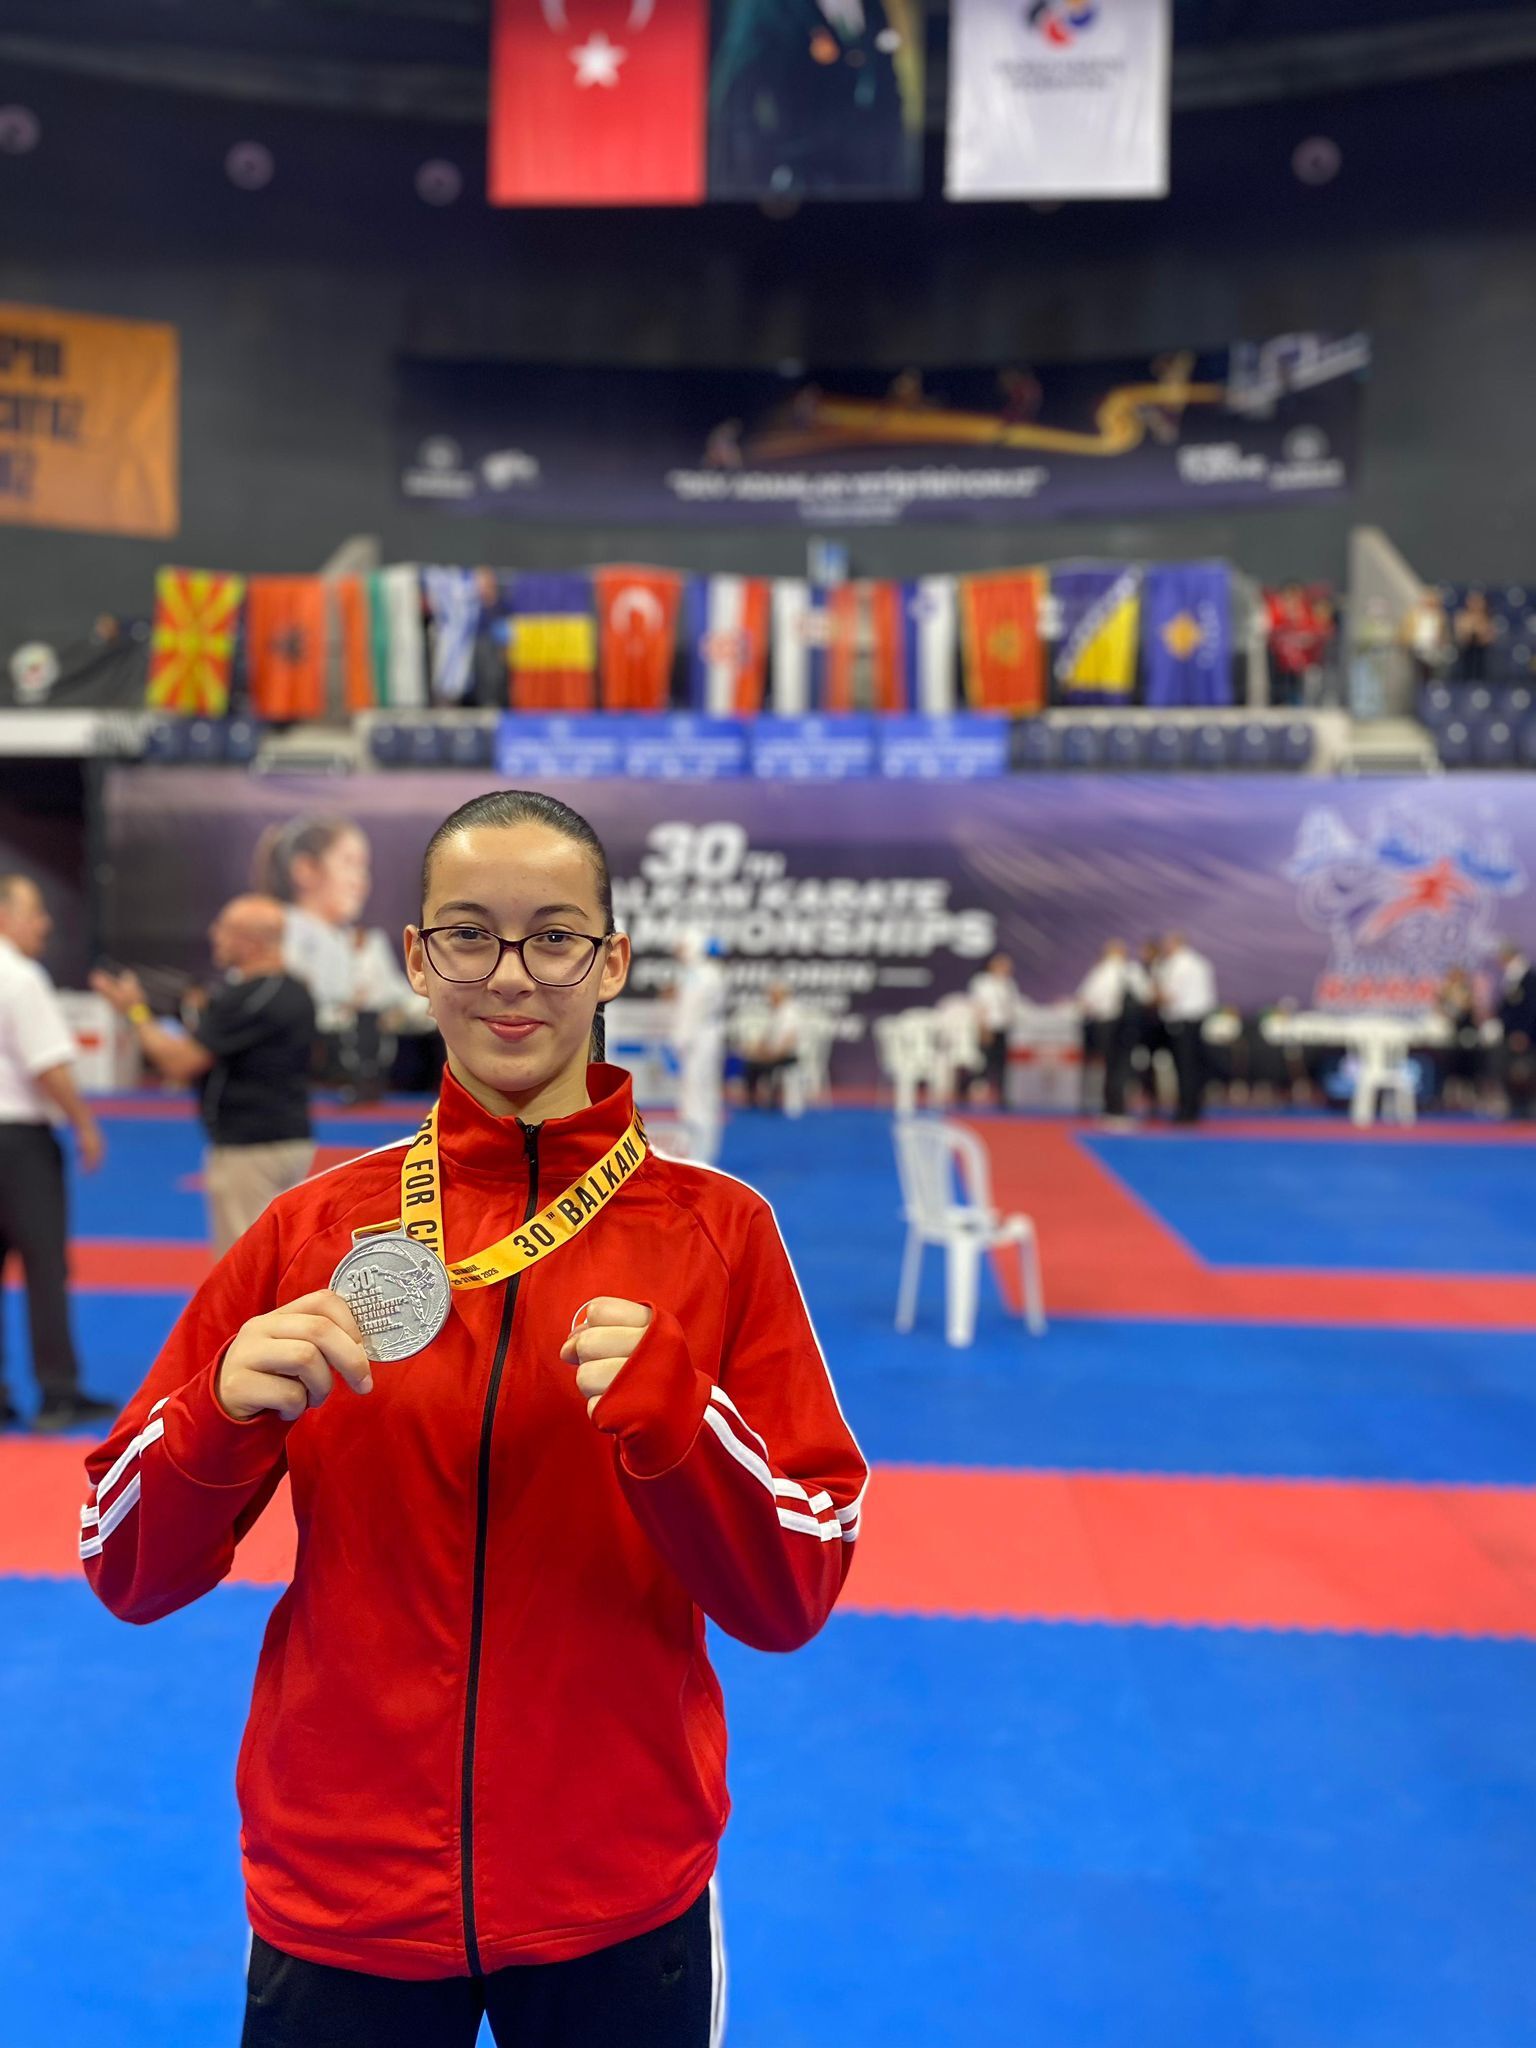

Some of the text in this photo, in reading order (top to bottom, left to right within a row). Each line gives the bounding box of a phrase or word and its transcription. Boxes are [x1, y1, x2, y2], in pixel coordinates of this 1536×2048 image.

[641, 822, 748, 881] 30
[761, 876, 951, 913] KARATE
[405, 1159, 435, 1208] FOR
[513, 1223, 555, 1258] 30
[546, 1211, 556, 1221] TH
[557, 1136, 640, 1226] BALKAN
[347, 1266, 376, 1293] 30
